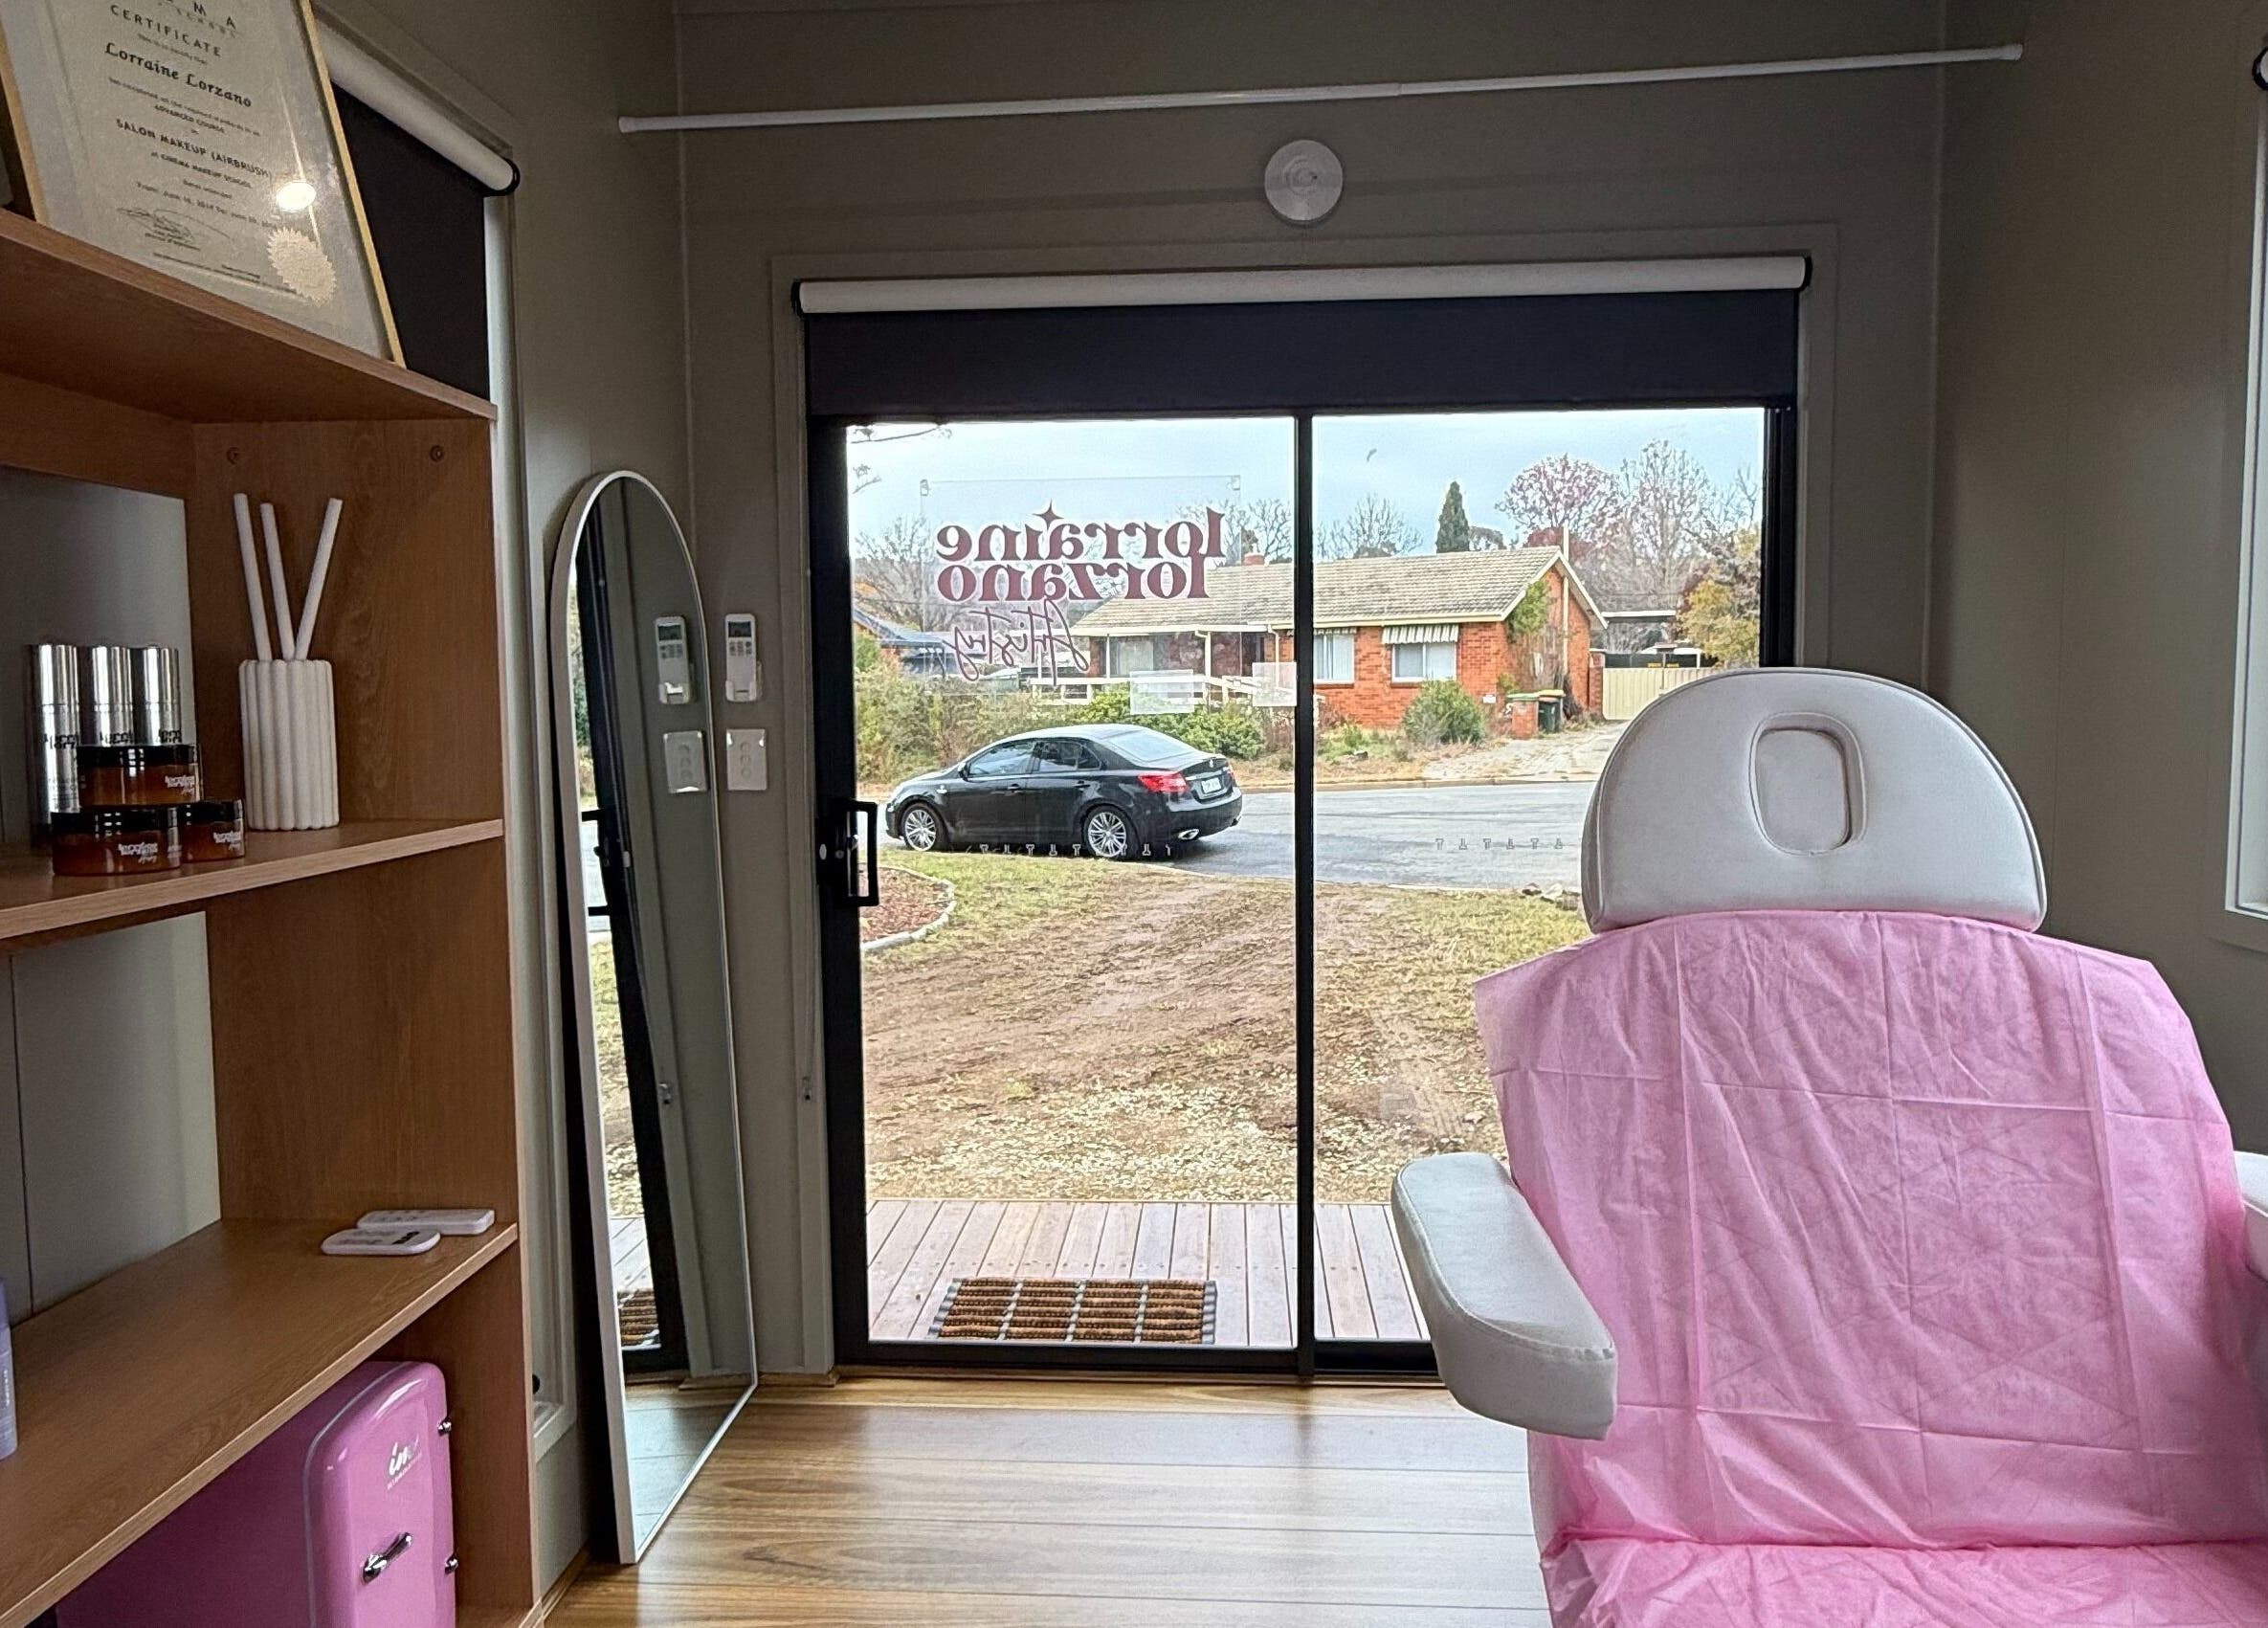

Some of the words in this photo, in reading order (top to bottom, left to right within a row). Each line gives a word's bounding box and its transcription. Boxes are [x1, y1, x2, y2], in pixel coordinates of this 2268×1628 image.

[110, 5, 221, 56] CERTIFICATE
[104, 42, 180, 80] Lorraine
[186, 74, 252, 107] Lorzano
[116, 118, 156, 139] SALON
[160, 134, 207, 156] MAKEUP
